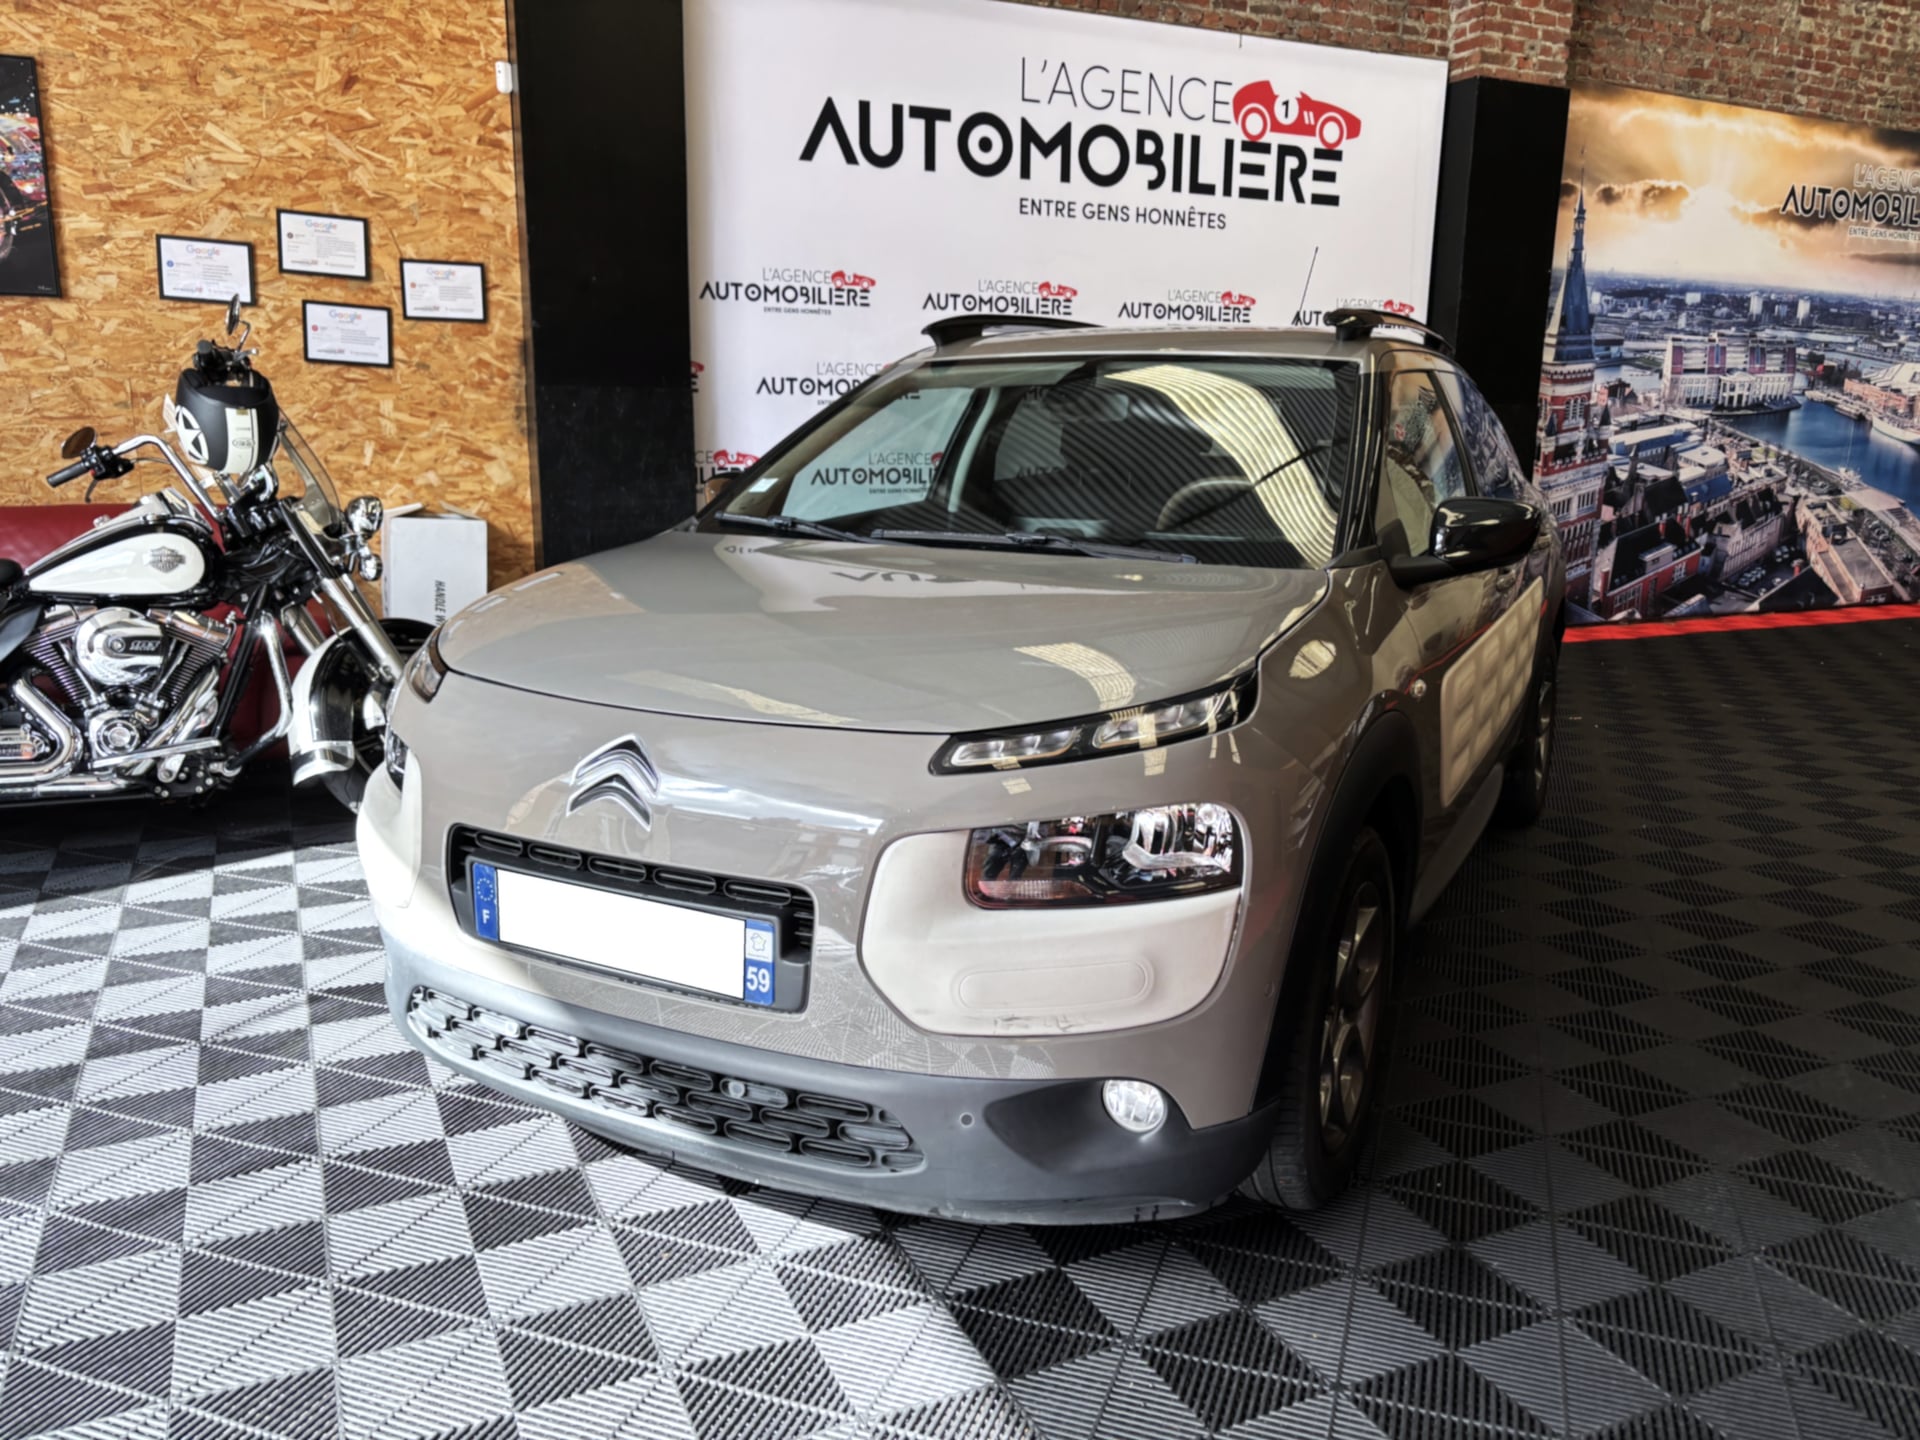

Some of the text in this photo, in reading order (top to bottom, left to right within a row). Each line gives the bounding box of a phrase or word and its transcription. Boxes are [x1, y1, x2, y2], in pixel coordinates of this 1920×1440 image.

[1020, 57, 1232, 124] L'AGENCE
[1281, 99, 1291, 119] 1
[1019, 198, 1227, 229] ENTRE GENS HONNÊTES
[305, 219, 337, 232] Google
[1849, 227, 1868, 238] ENTRE
[1870, 229, 1887, 239] GENS
[185, 244, 220, 257] Google
[426, 267, 456, 280] Google
[762, 267, 832, 284] L'AGENCE
[978, 279, 1039, 295] L'AGENCE
[1168, 289, 1221, 303] L'AGENCE
[329, 309, 362, 322] Google
[868, 452, 931, 466] L'AGENCE
[434, 580, 446, 613] HANDLE
[482, 909, 490, 924] F
[746, 965, 770, 993] 59
